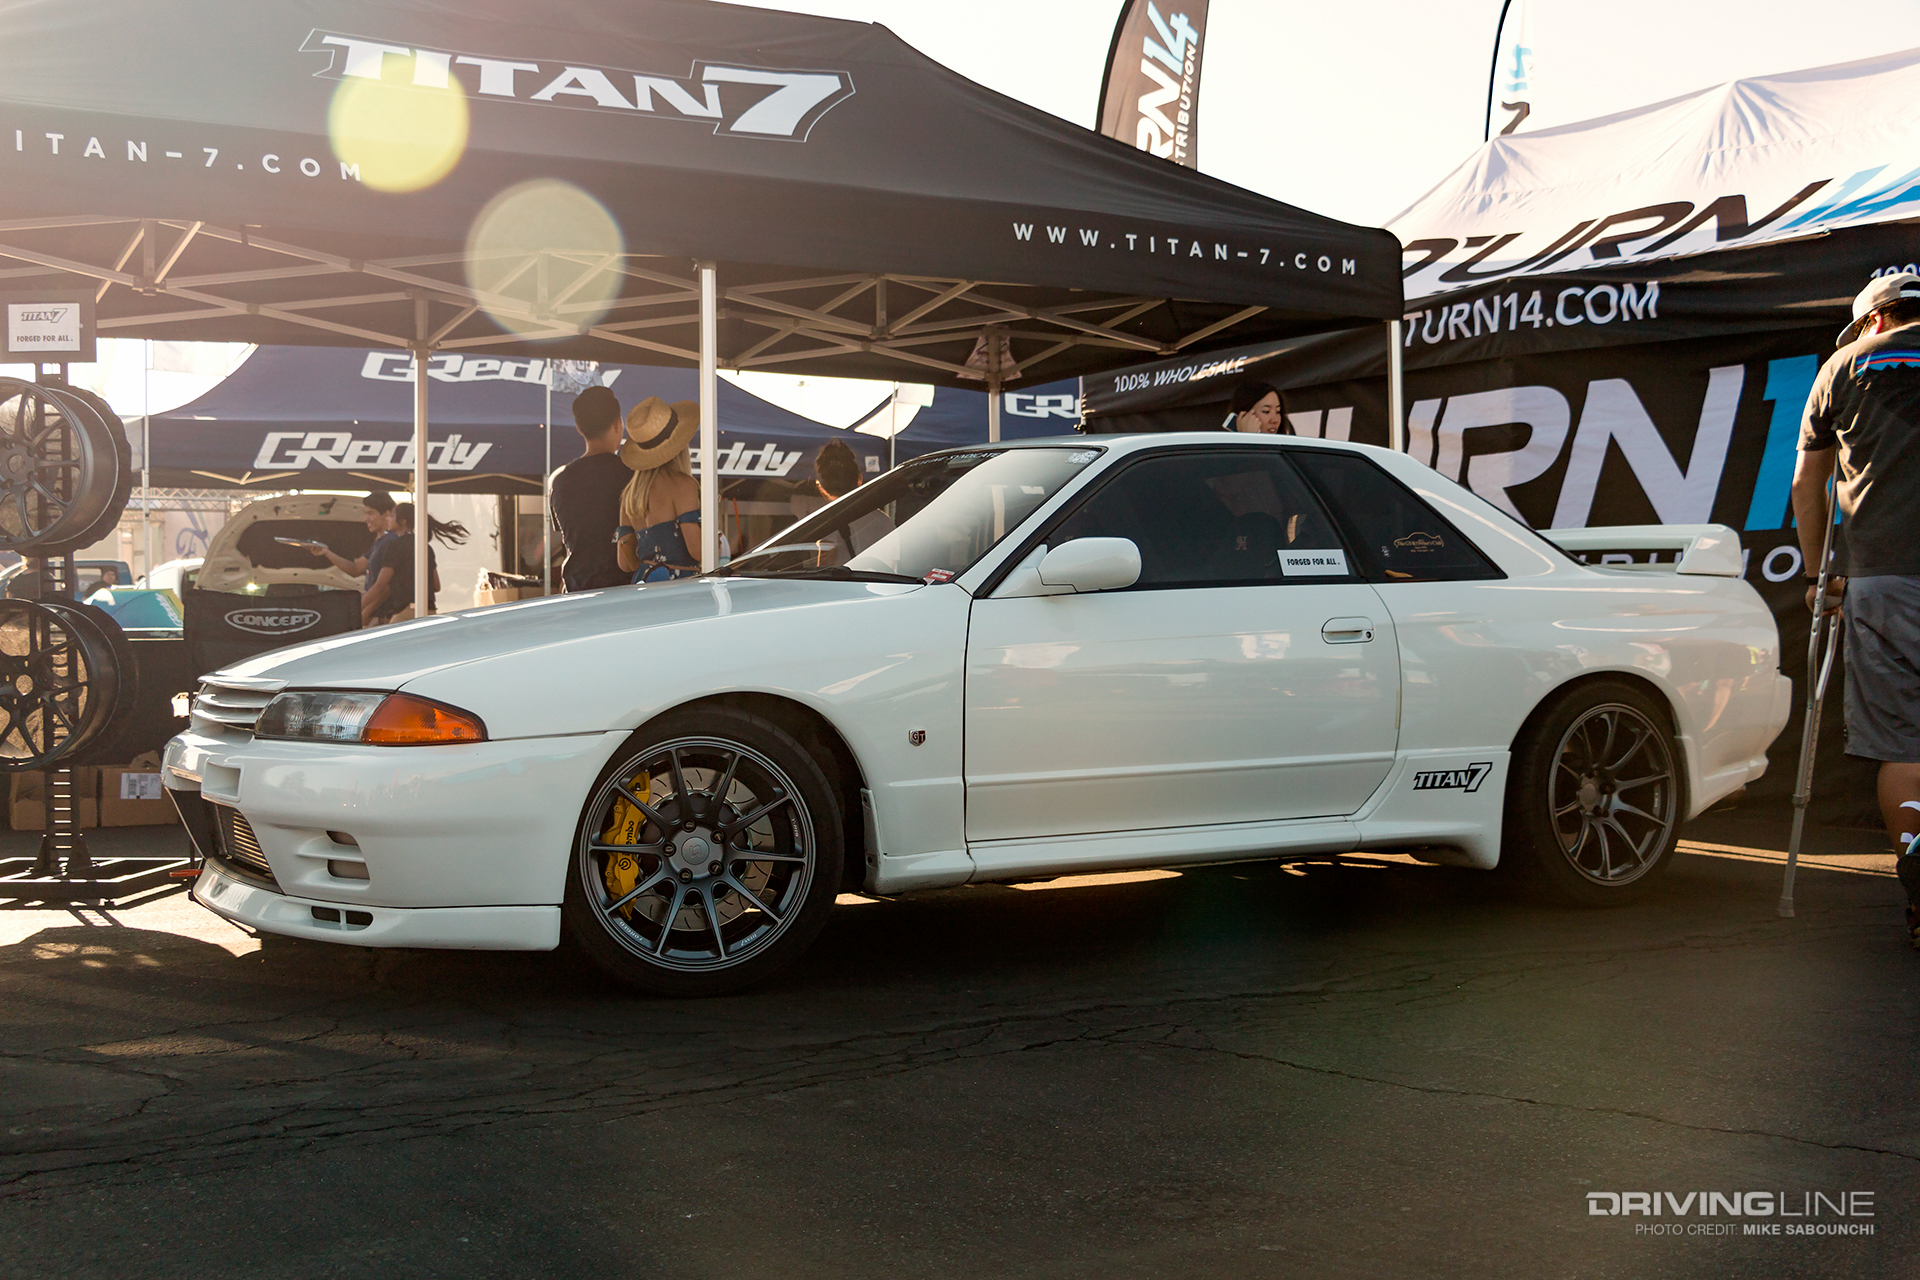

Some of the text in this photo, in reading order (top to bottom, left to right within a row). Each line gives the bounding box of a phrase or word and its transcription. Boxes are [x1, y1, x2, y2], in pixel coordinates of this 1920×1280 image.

[322, 35, 842, 136] TITAN7
[15, 129, 362, 182] ITAN-7.COM
[1013, 222, 1357, 276] WWW.TITAN-7.COM
[21, 308, 68, 323] TITAN7
[16, 335, 41, 343] FORGED
[1114, 355, 1248, 393] 100% WHOLESALE
[1287, 558, 1311, 566] FORGED
[1312, 558, 1325, 566] FOR
[232, 613, 314, 627] CONCEPT
[1413, 762, 1493, 793] TITAN7
